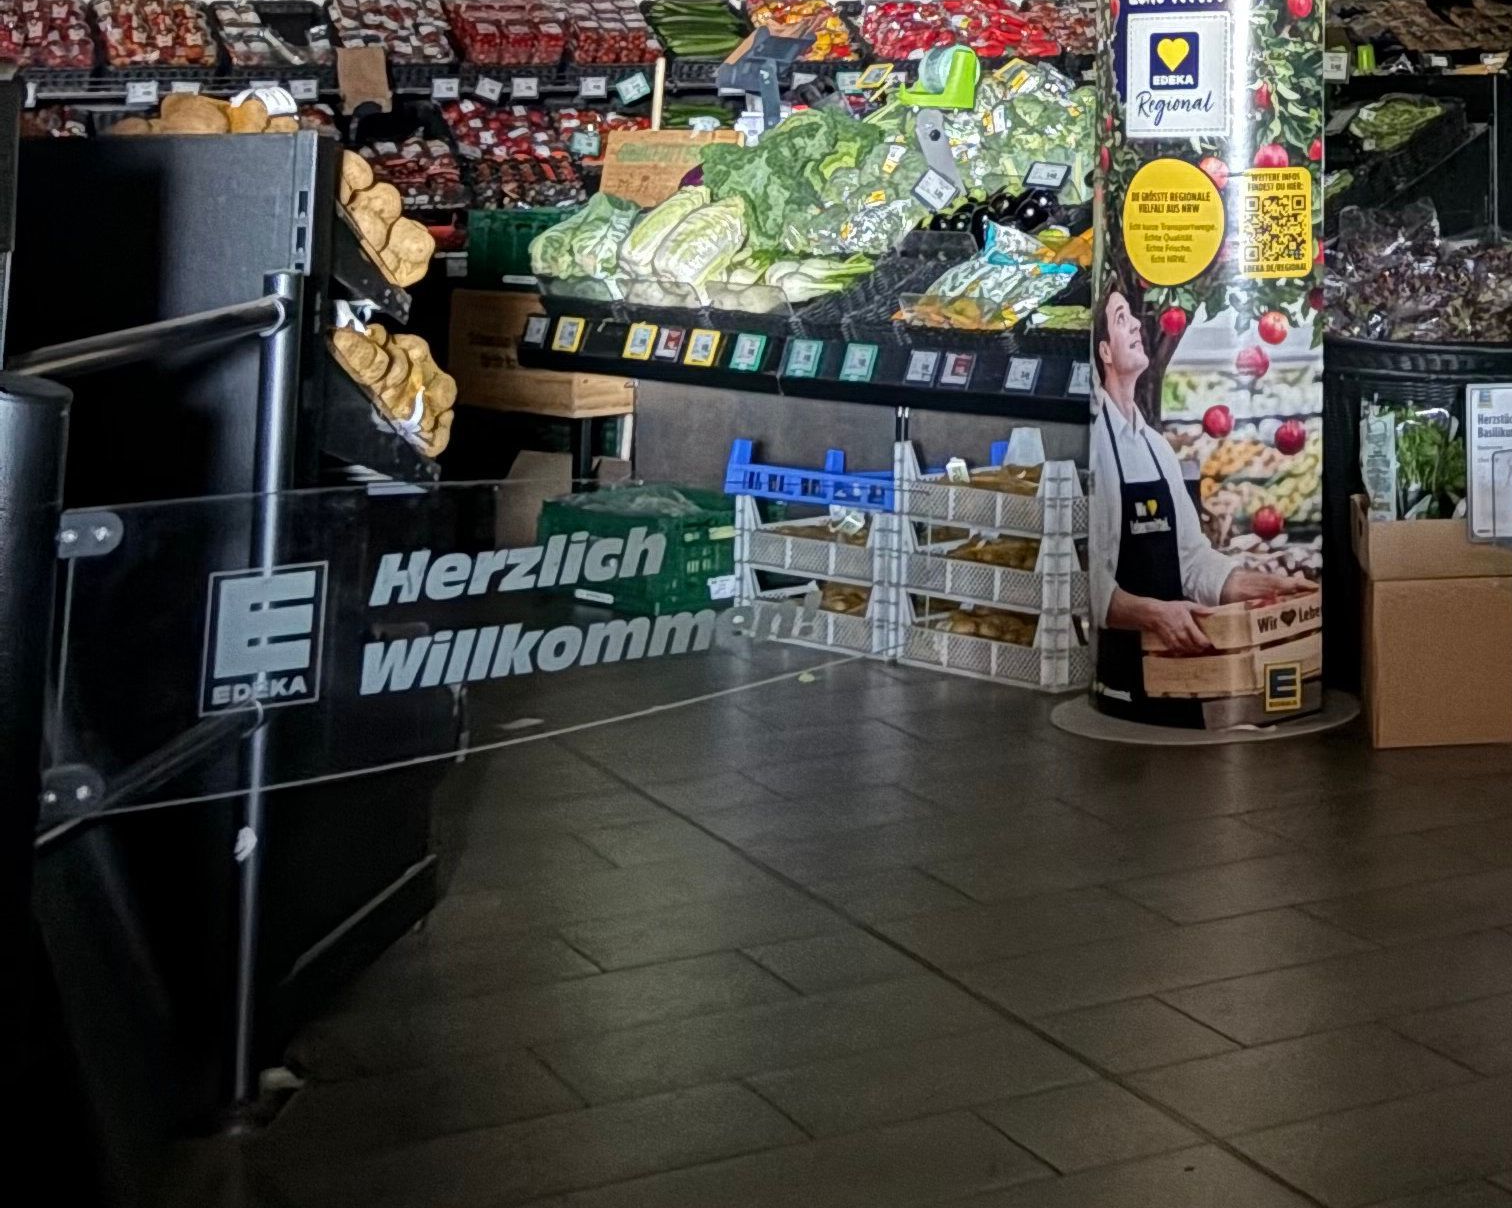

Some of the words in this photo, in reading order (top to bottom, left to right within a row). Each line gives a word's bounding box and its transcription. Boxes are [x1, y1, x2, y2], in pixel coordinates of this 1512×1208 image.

[1152, 75, 1194, 86] EDEKA
[1136, 90, 1214, 126] Regional
[369, 526, 667, 607] Herzlich
[1257, 615, 1279, 633] Wir
[210, 674, 309, 705] EDEKA
